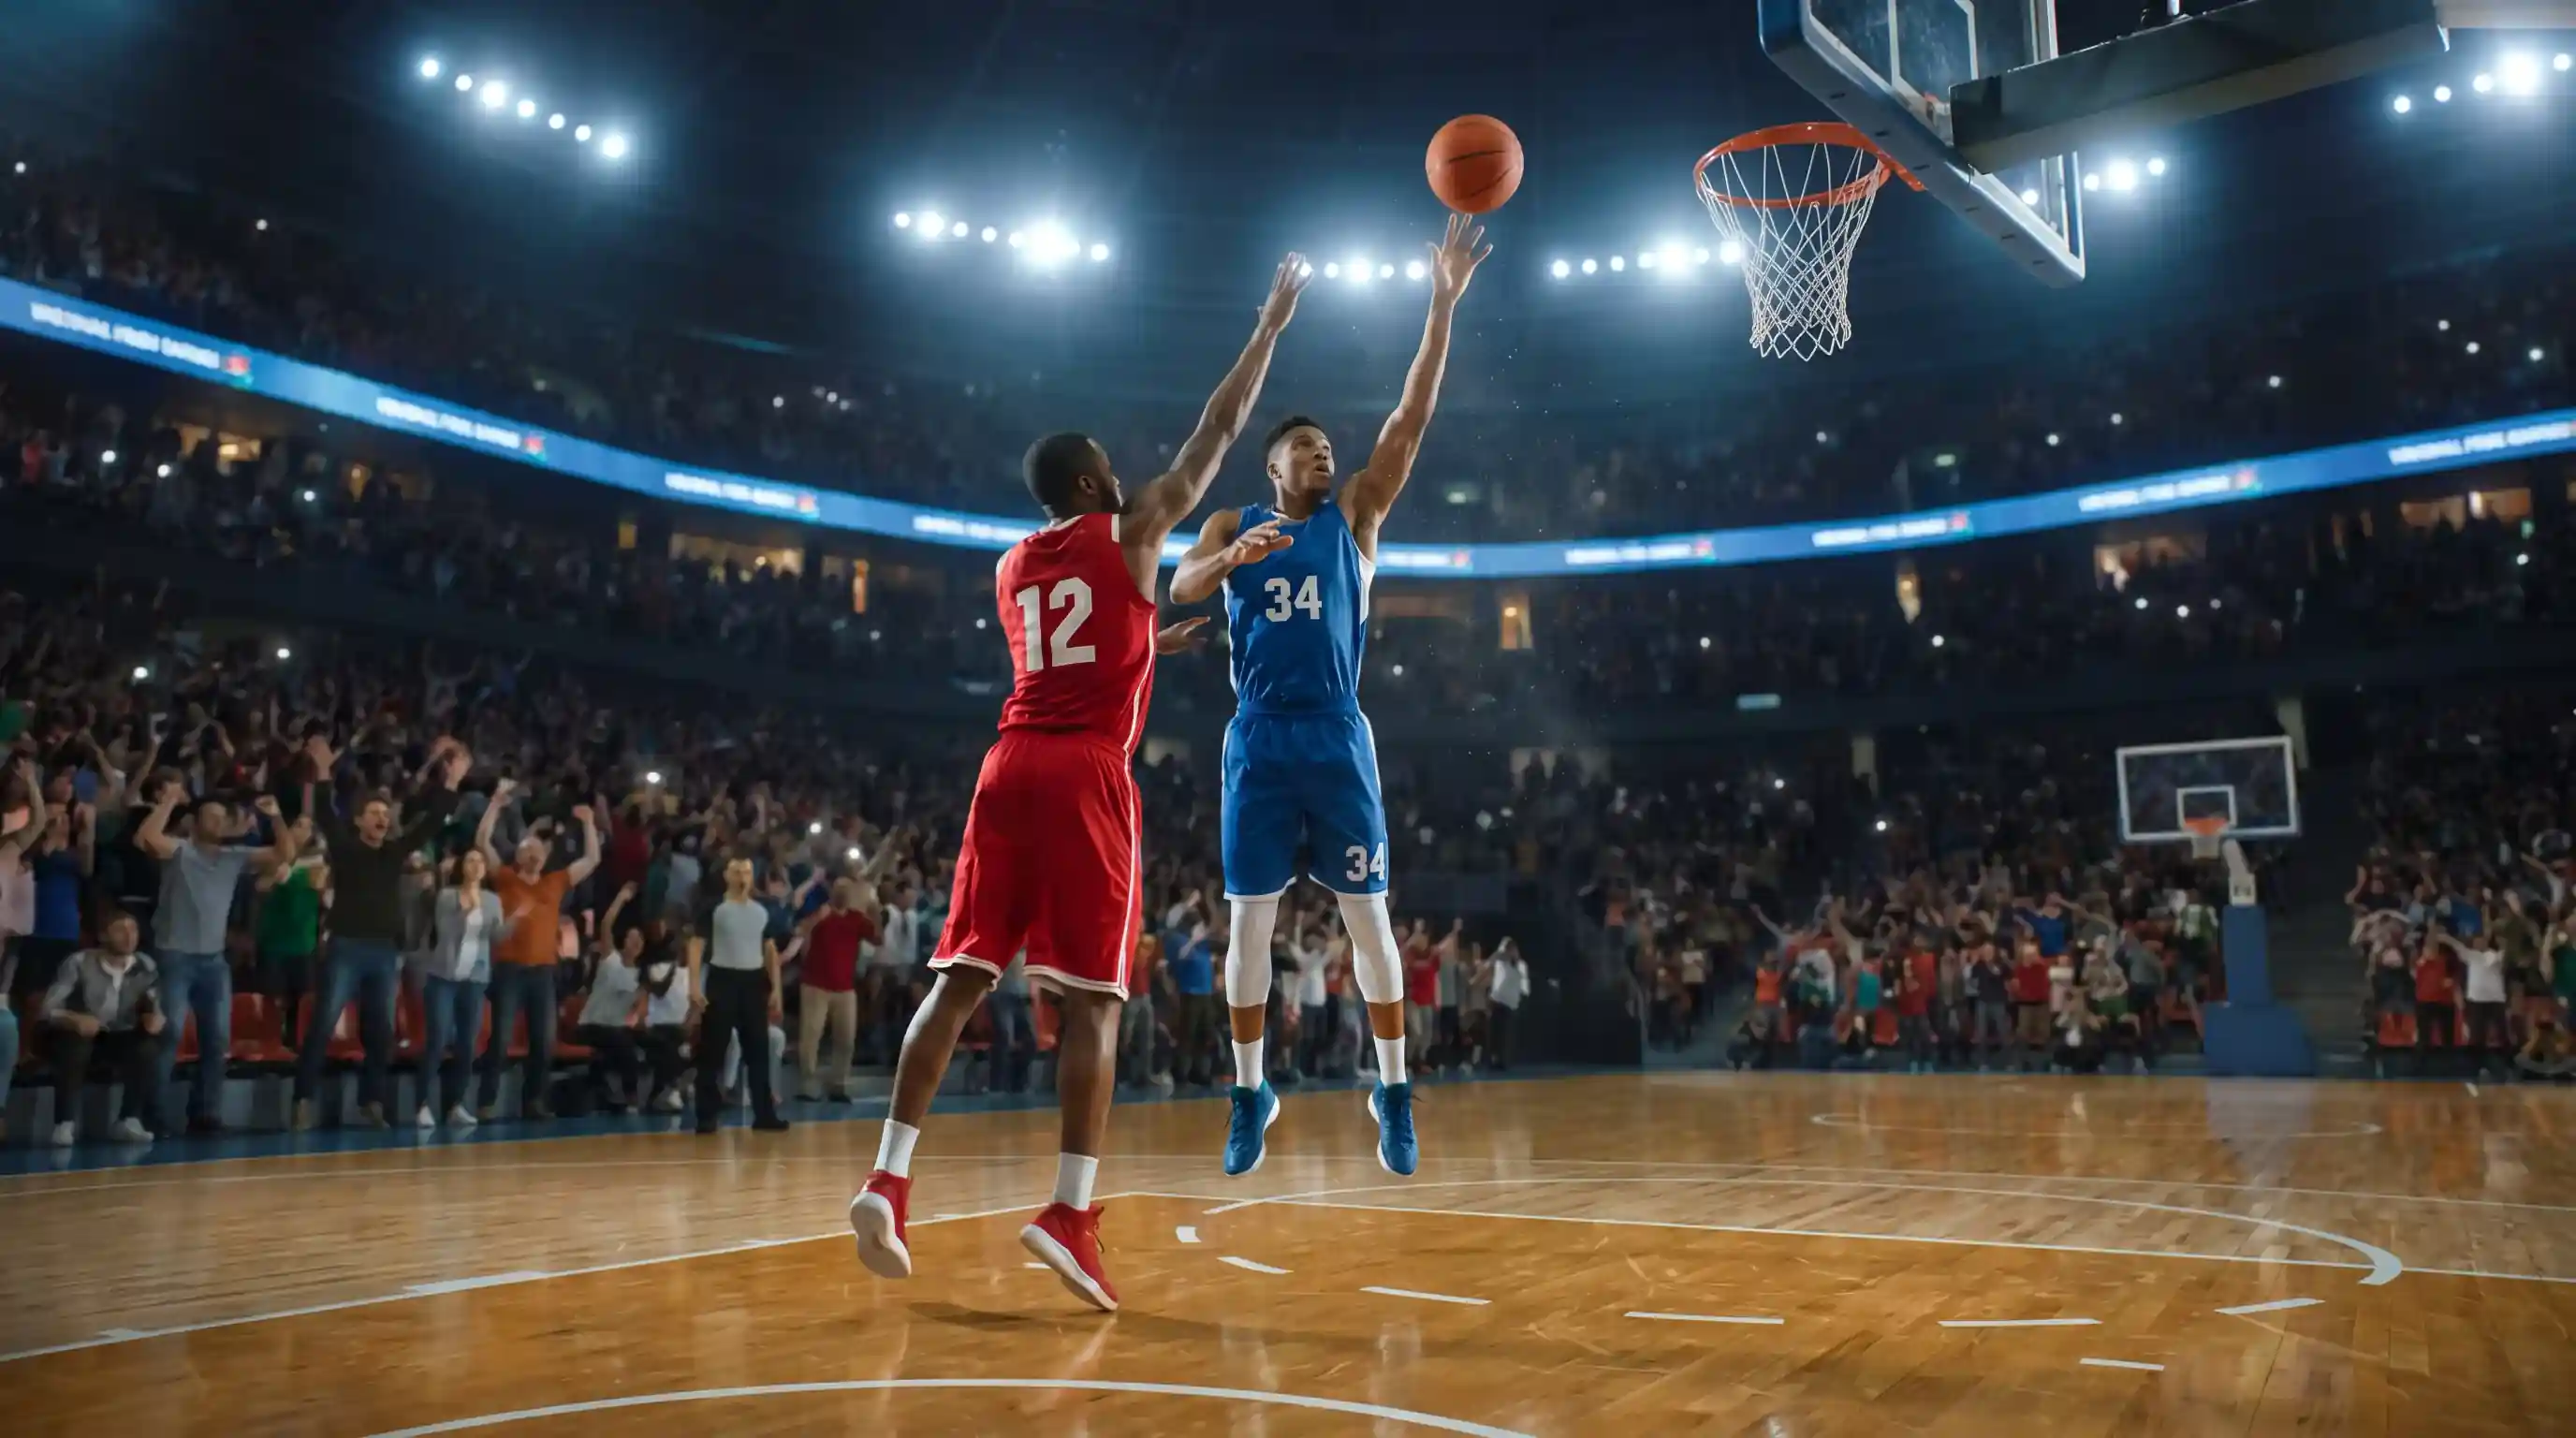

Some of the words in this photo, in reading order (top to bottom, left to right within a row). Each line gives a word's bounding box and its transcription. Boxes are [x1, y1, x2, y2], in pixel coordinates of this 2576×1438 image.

[1265, 575, 1323, 623] 34
[1017, 577, 1096, 672] 12
[1345, 843, 1385, 882] 34
